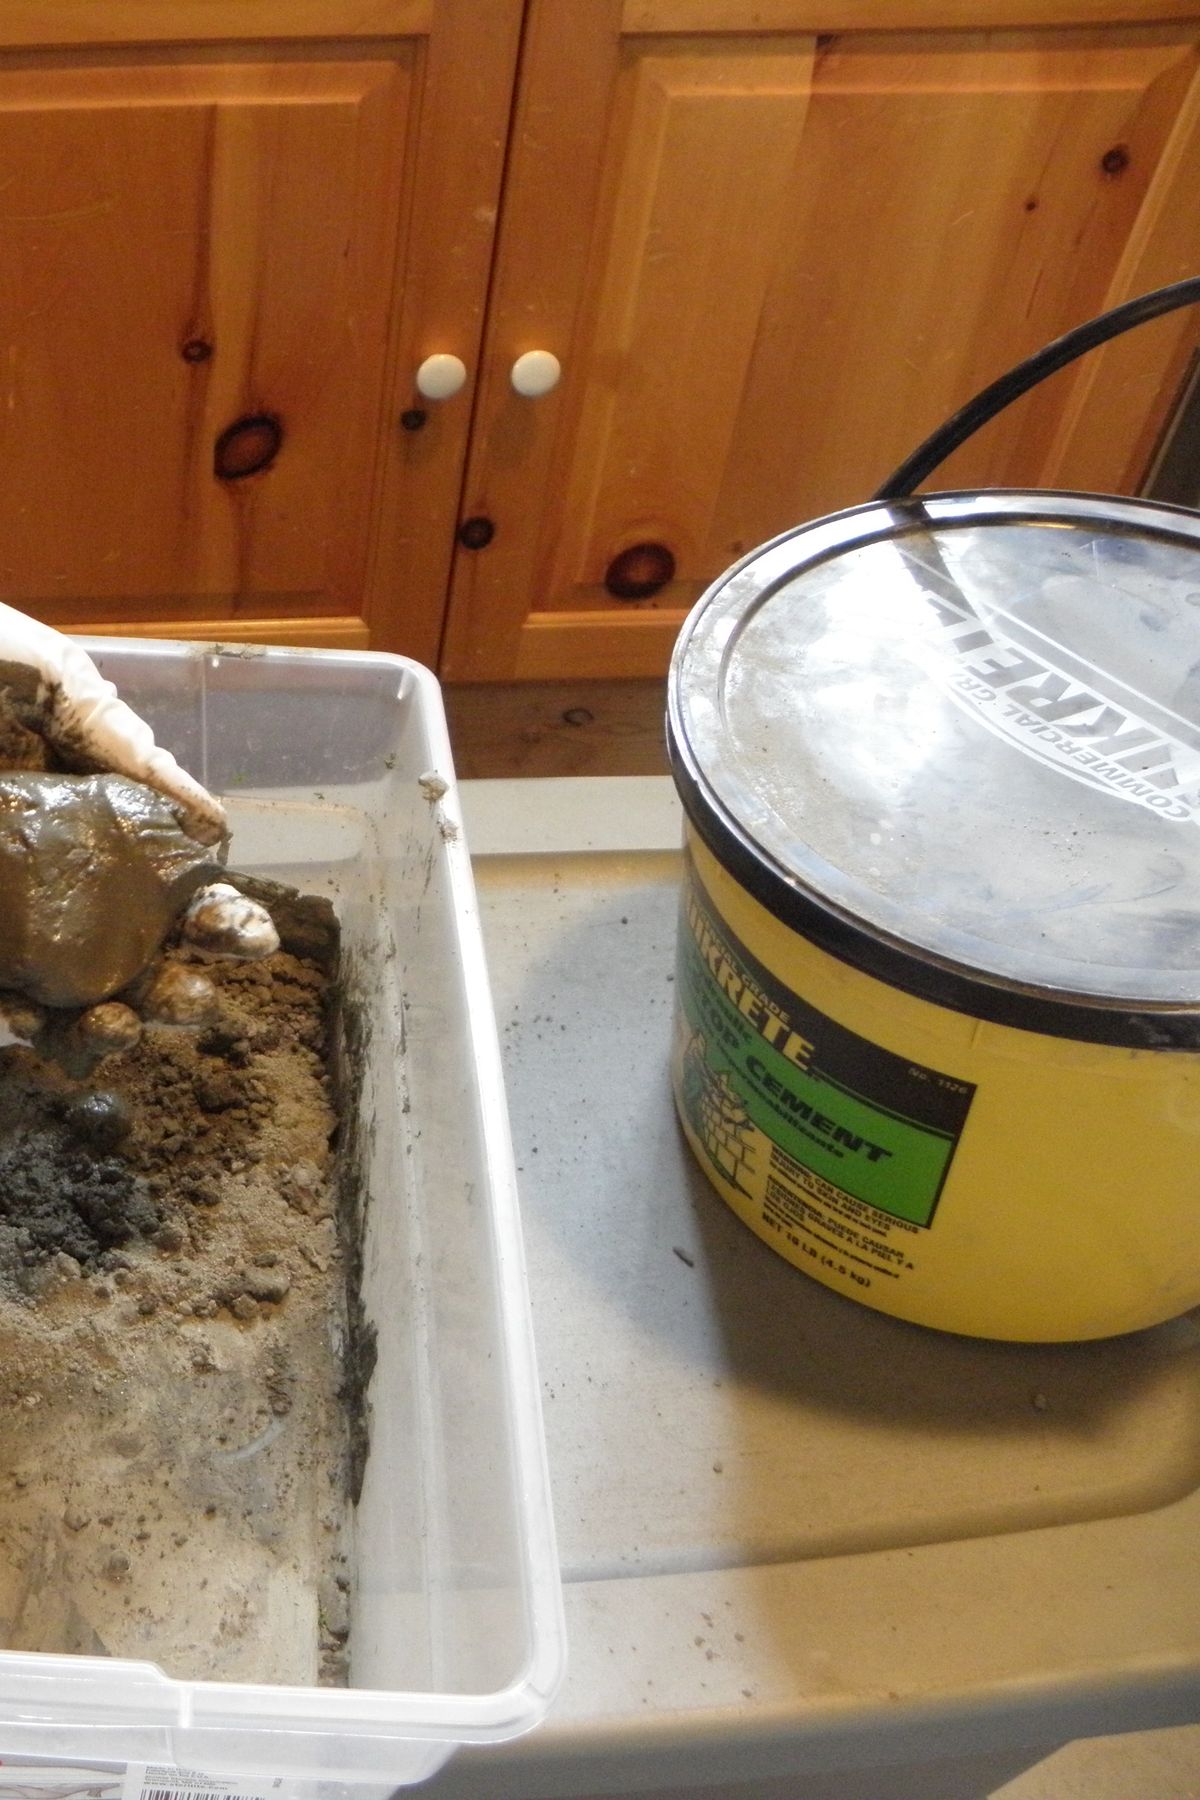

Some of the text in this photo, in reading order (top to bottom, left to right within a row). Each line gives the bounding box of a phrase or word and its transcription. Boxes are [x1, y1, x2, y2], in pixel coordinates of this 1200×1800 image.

[1001, 703, 1190, 818] COMMERCIAL
[741, 973, 791, 1024] GRADE
[745, 1054, 893, 1162] CEMENT
[815, 1178, 834, 1194] CAN
[836, 1189, 869, 1212] CAUSE
[872, 1208, 919, 1234] SERIOUS
[841, 1200, 862, 1218] AND
[865, 1212, 891, 1231] EYES
[762, 1211, 783, 1233] NET
[801, 1242, 818, 1259] LB
[820, 1254, 847, 1276] (4.5
[850, 1270, 872, 1288] kg)
[828, 1217, 859, 1239] PUEDE
[862, 1235, 905, 1259] CAUSAR
[871, 1248, 894, 1264] PIEL
